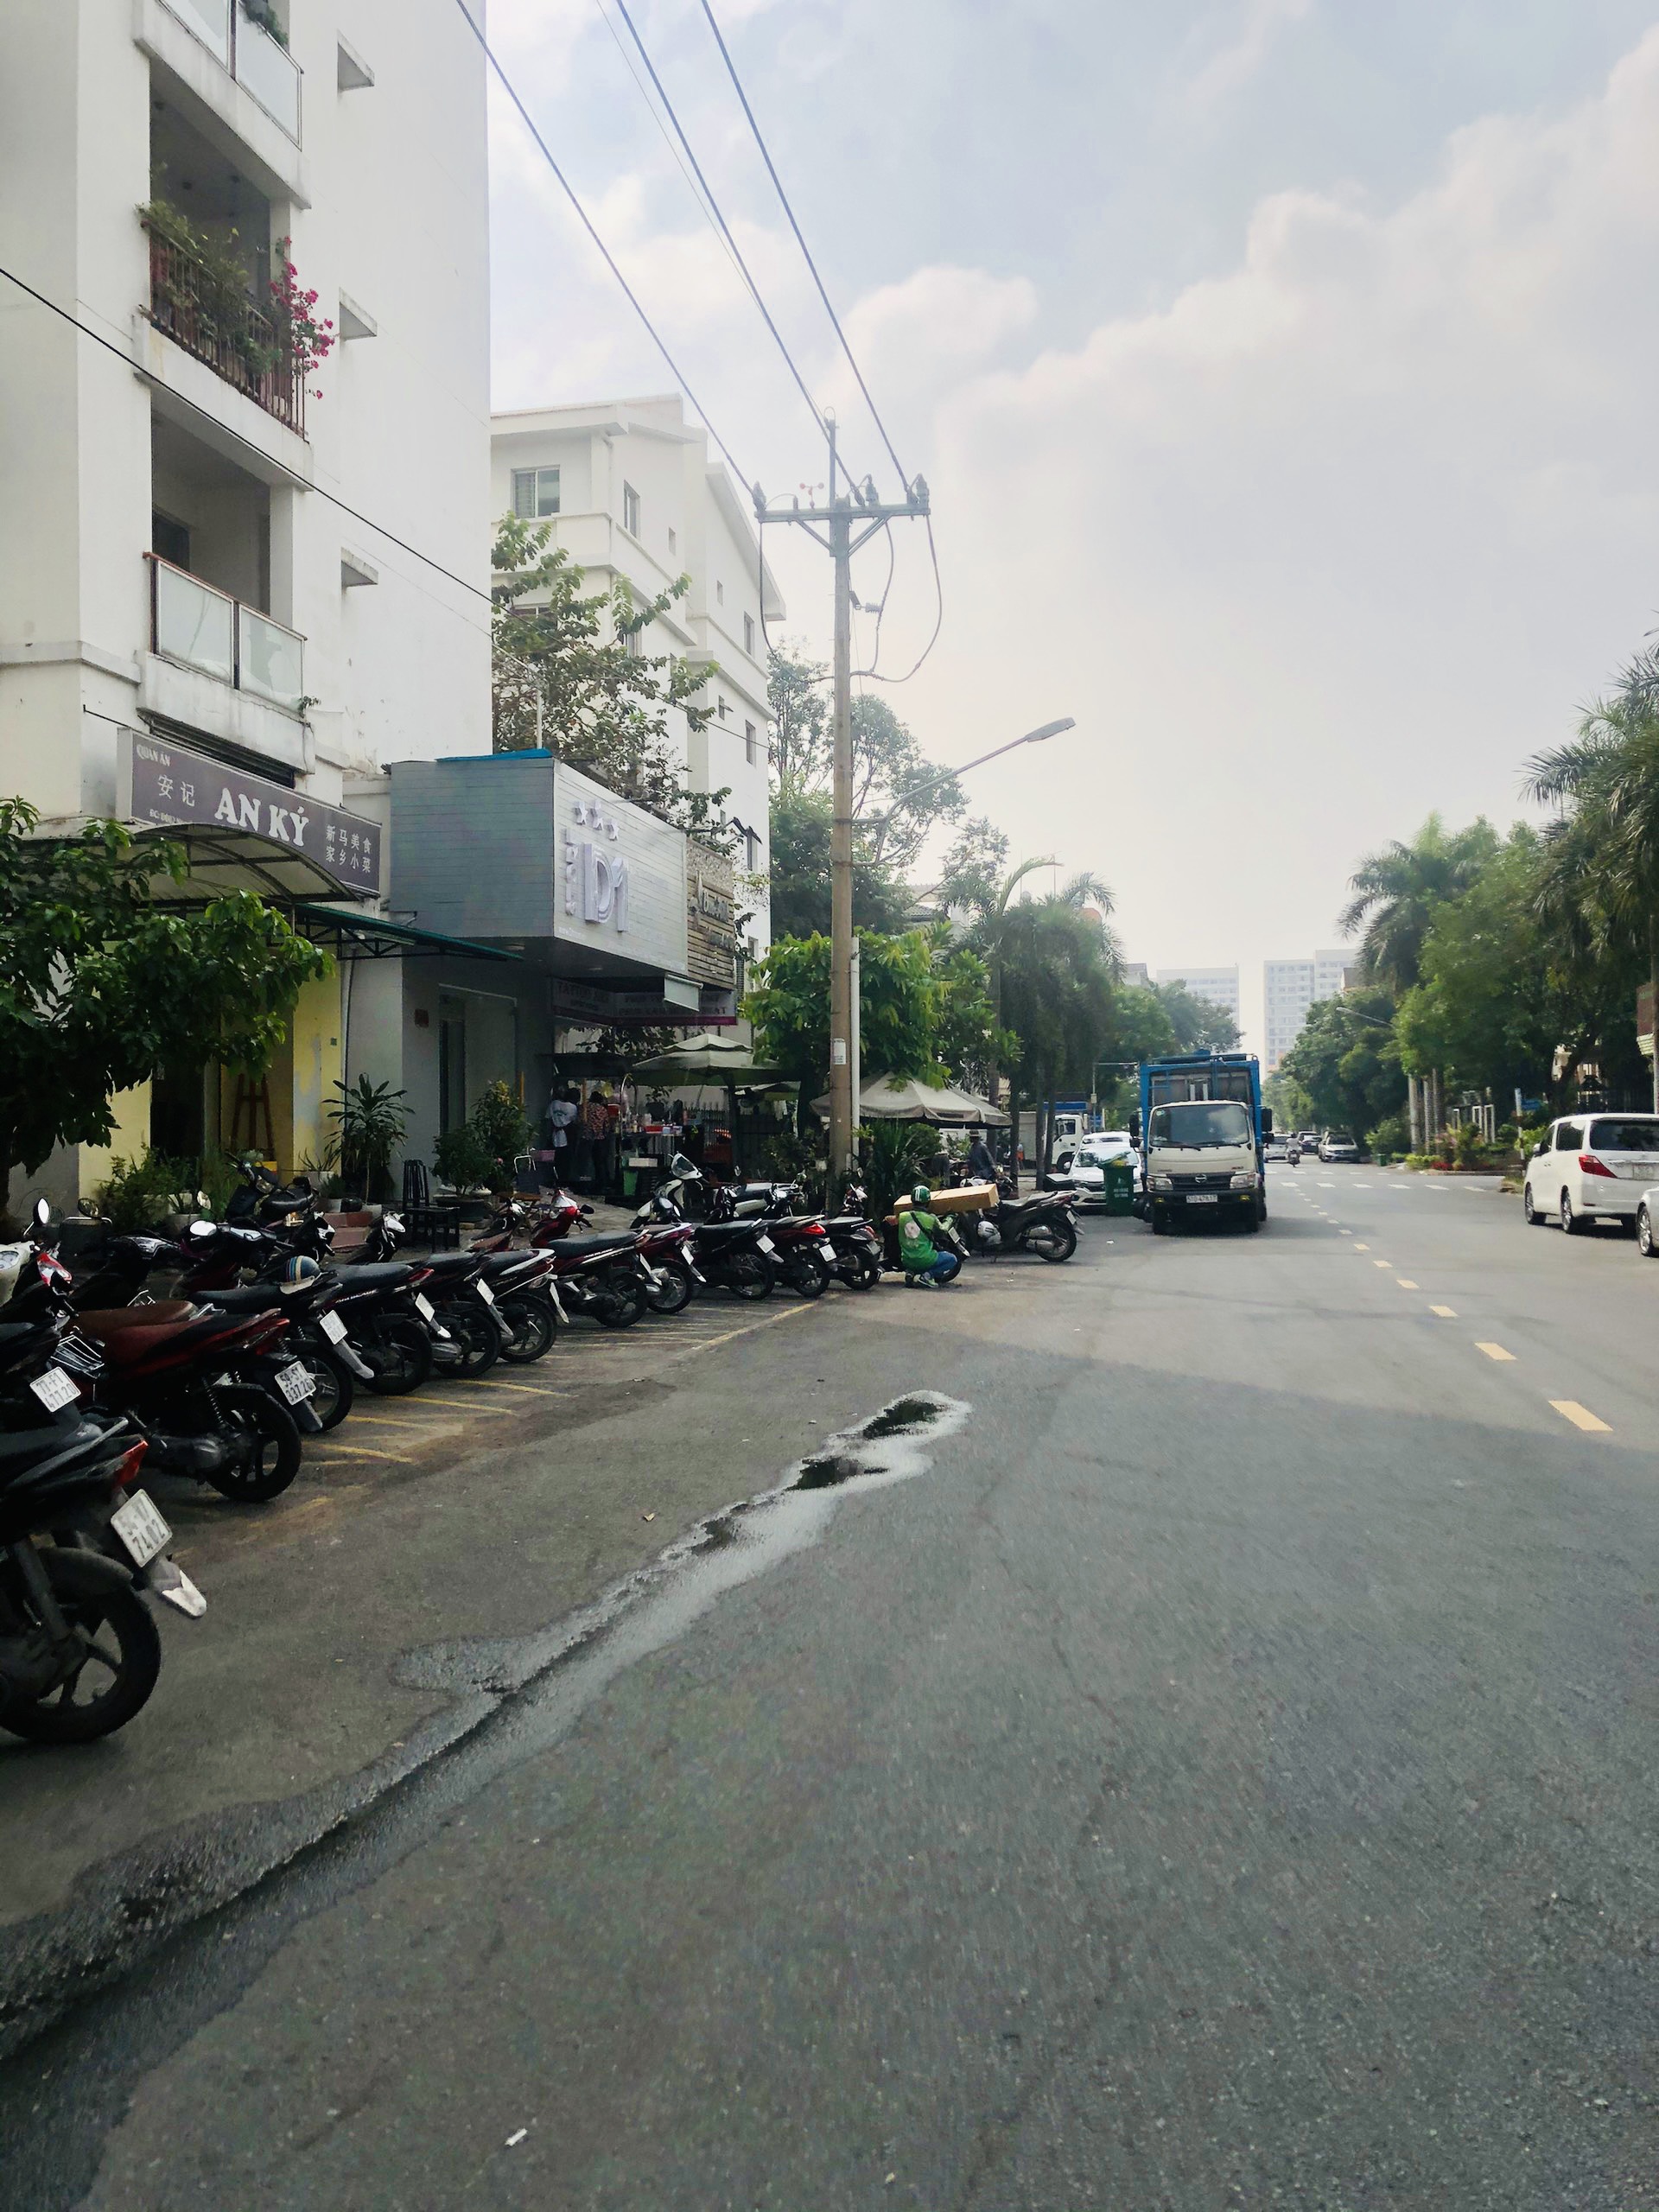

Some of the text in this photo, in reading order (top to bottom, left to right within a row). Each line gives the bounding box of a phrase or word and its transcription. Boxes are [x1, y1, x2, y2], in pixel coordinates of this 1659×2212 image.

[156, 774, 195, 807] 安记
[213, 787, 262, 832] AN
[325, 824, 372, 855] 新马美食
